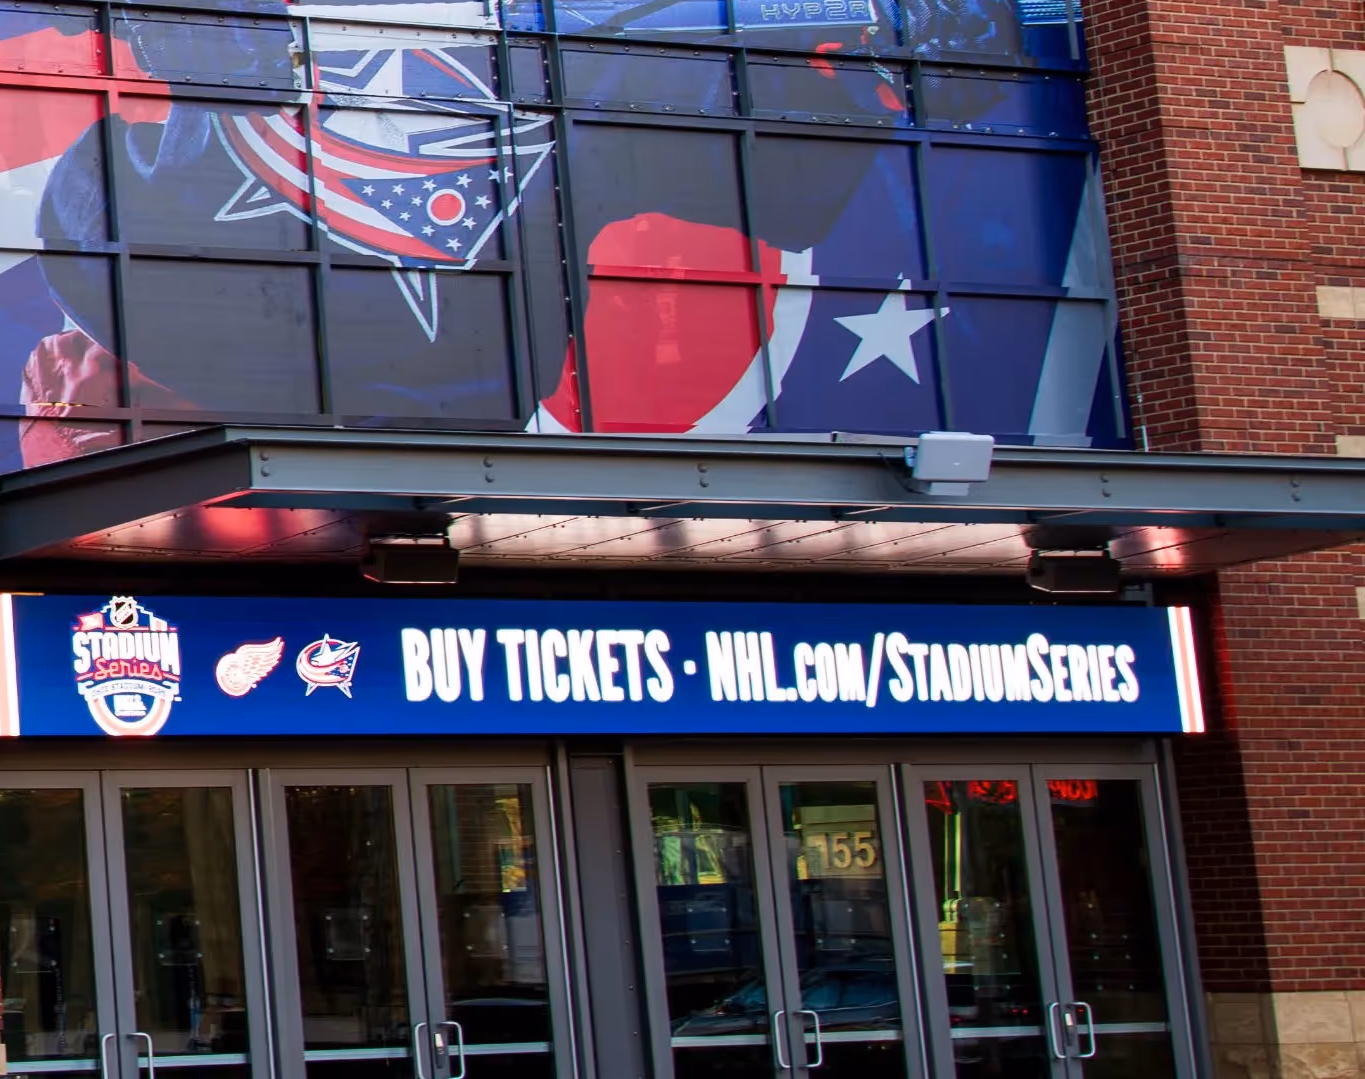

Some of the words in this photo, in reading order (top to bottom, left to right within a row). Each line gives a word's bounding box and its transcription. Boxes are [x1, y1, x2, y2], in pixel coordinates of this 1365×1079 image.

[72, 631, 180, 674] STADIUM
[94, 657, 163, 681] Series
[400, 627, 487, 702] BUY
[496, 629, 673, 703] TICKETS
